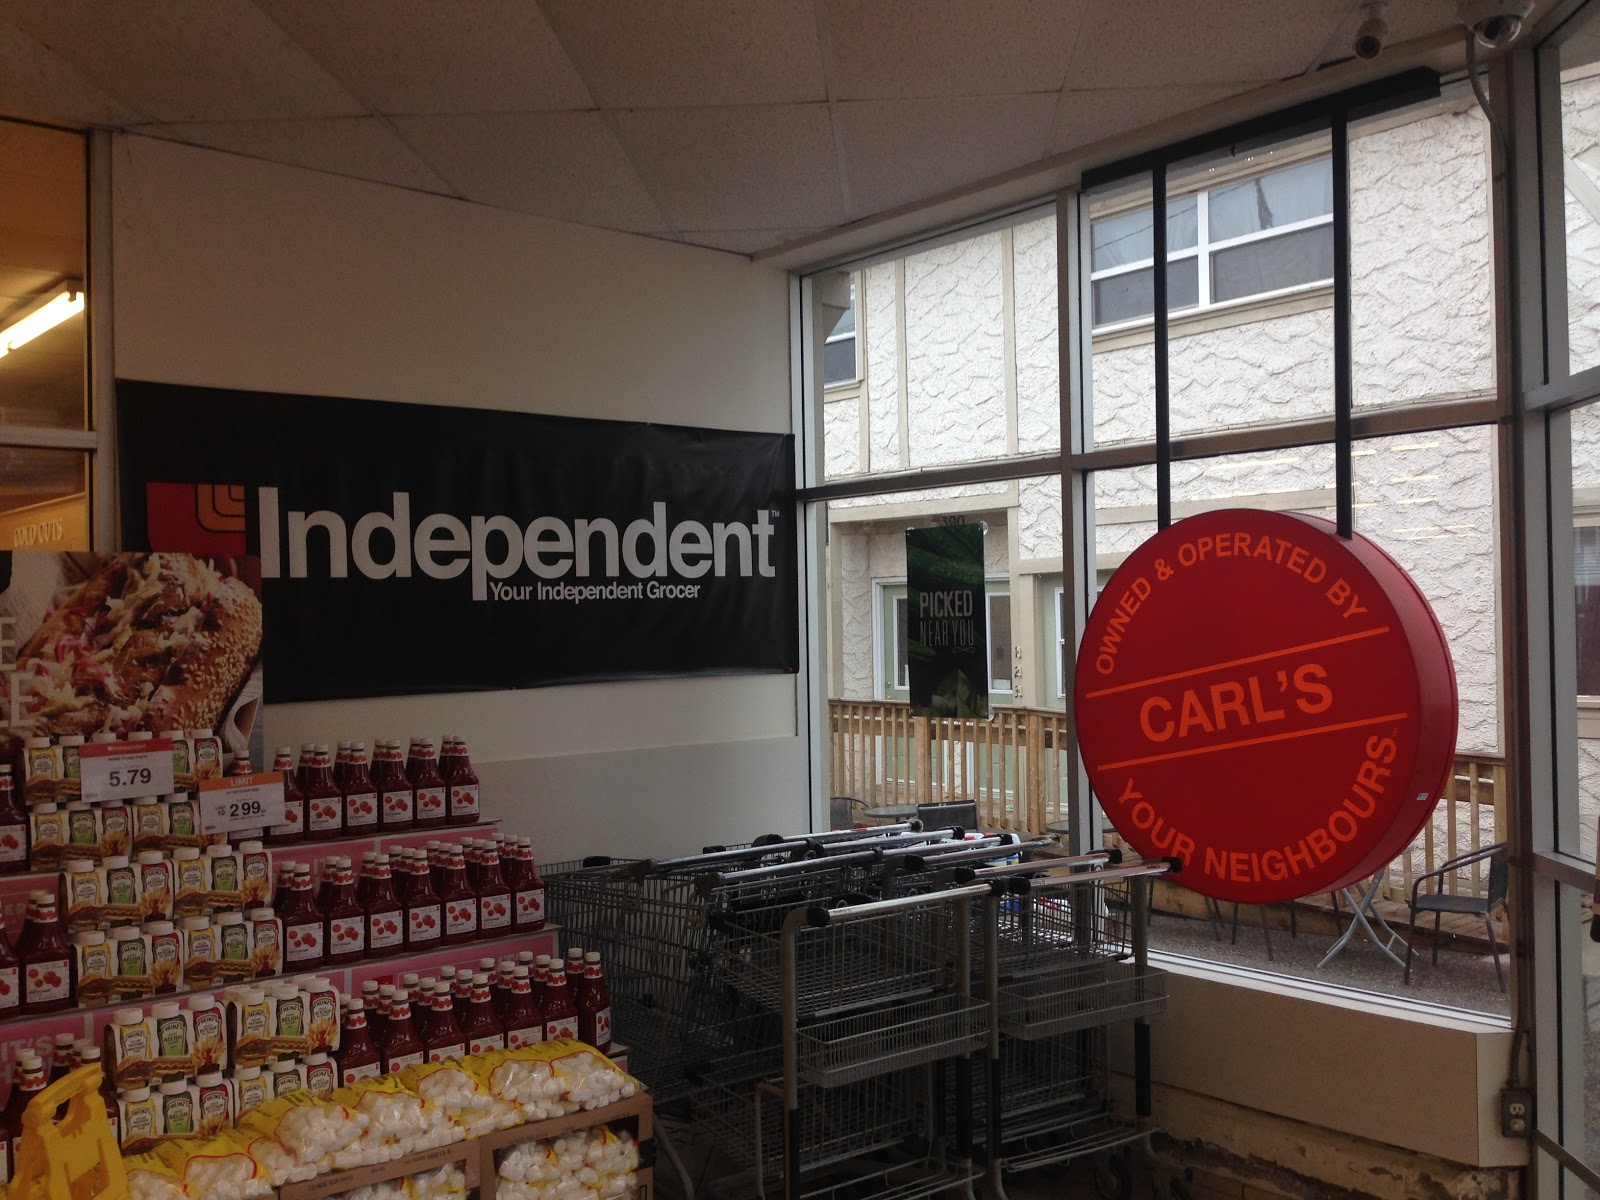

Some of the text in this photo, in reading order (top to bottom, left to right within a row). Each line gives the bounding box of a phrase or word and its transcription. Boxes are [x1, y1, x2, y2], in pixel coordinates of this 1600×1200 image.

[39, 519, 63, 542] CUTS
[258, 486, 776, 602] Independent
[489, 579, 700, 604] Your Independent Grocer
[919, 589, 973, 618] PICKED
[1096, 532, 1367, 675] OWNED & OPERATED BY
[919, 618, 974, 647] NEAR YOU
[1139, 663, 1333, 742] CARL'S
[109, 768, 151, 787] 5.79
[230, 776, 254, 786] LIMIT
[1118, 777, 1195, 865] YOUR
[1205, 735, 1397, 882] NEIGHBOURS
